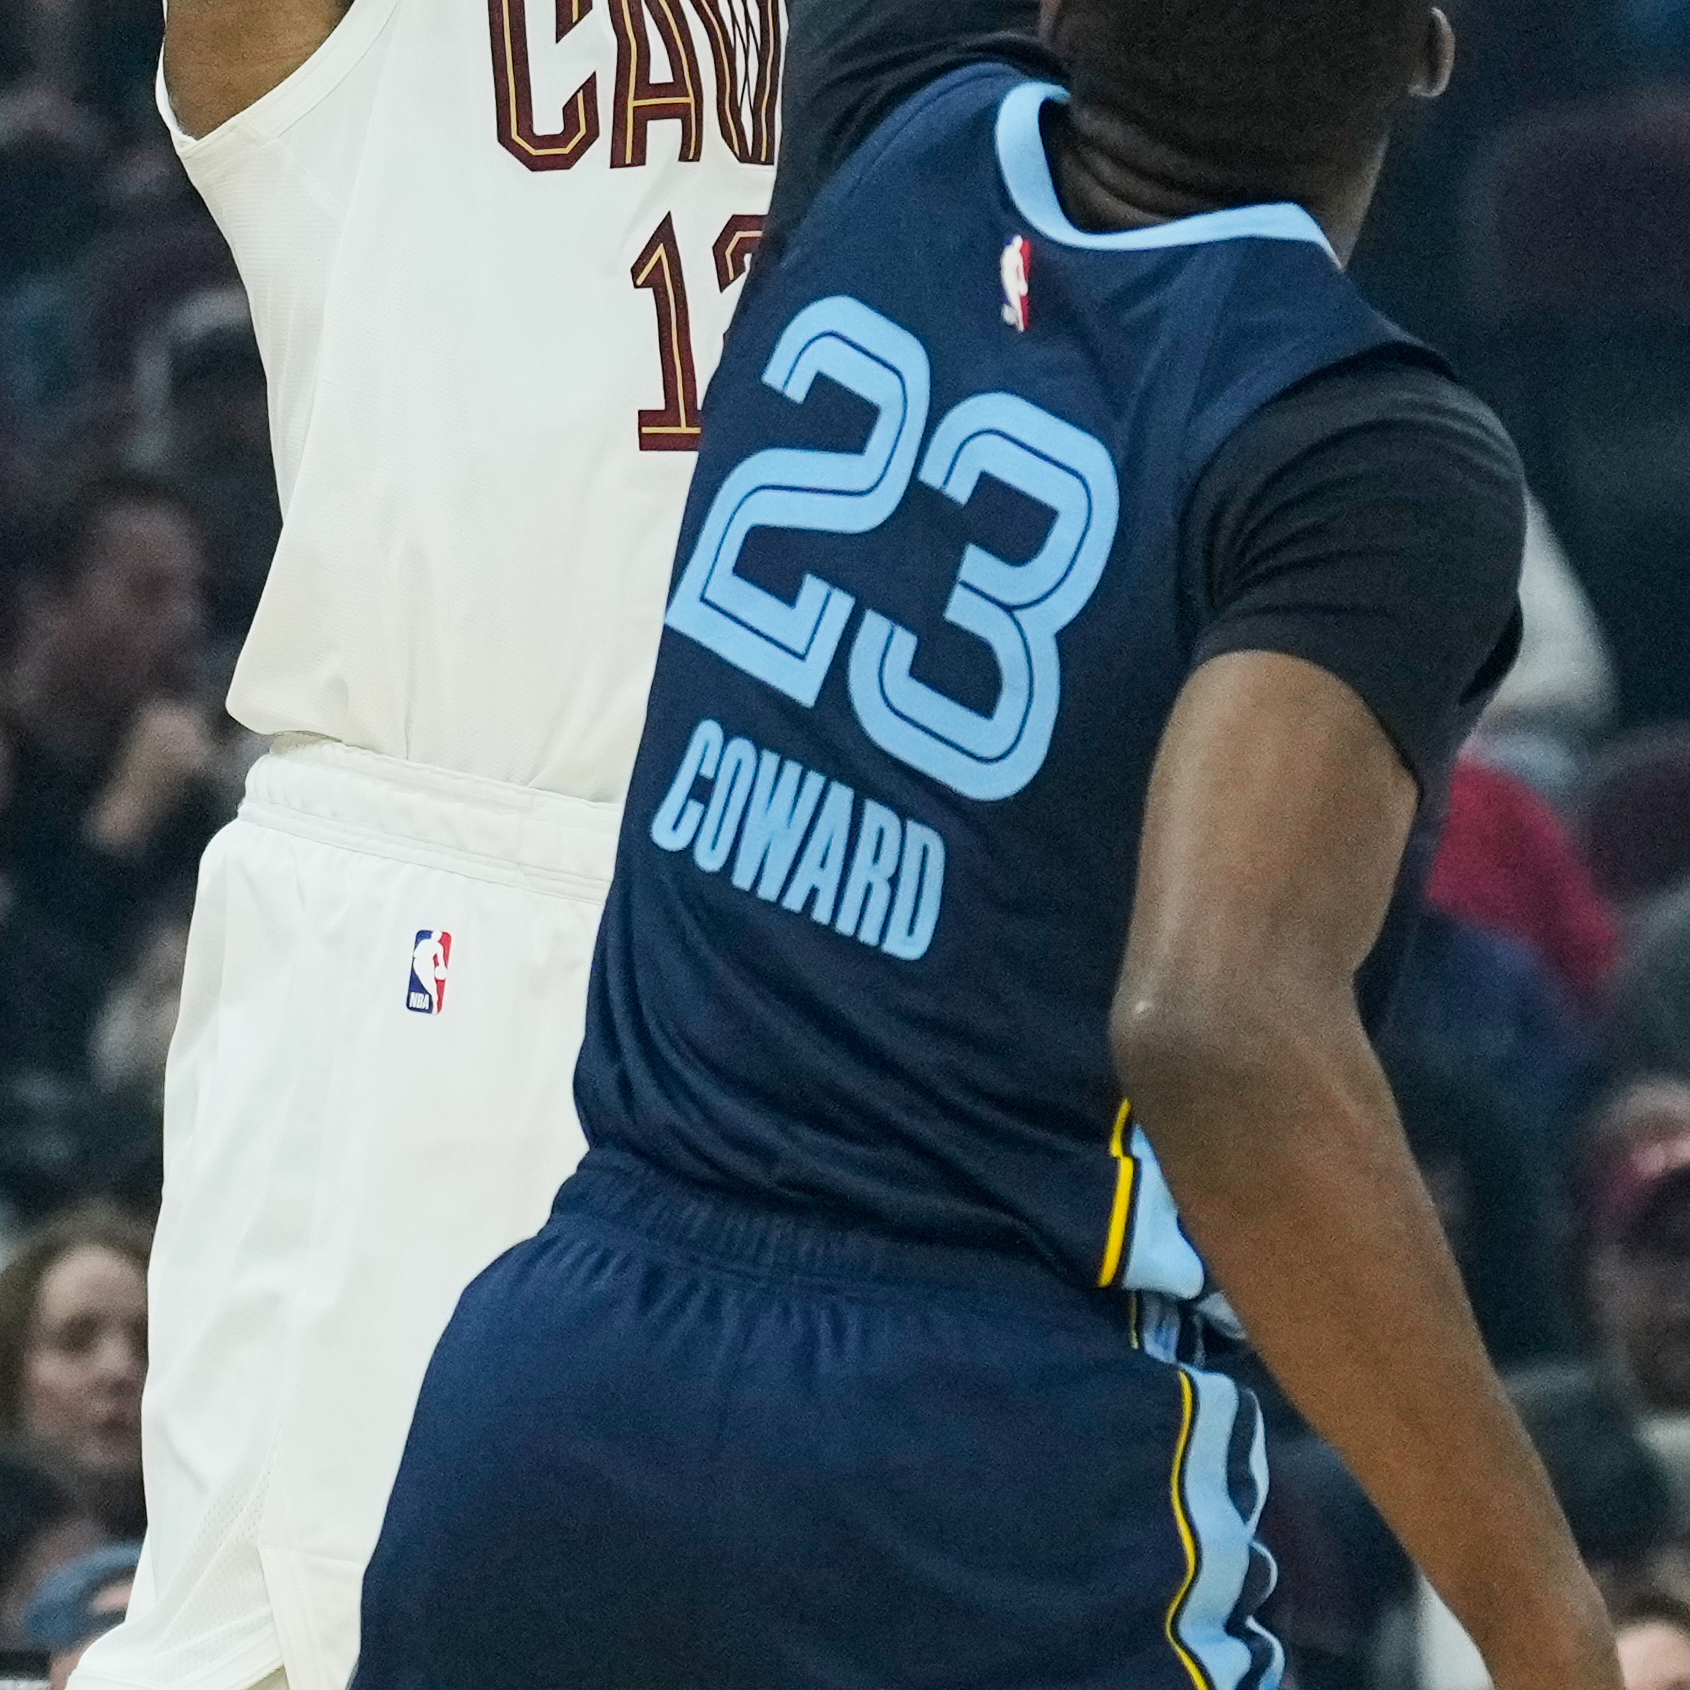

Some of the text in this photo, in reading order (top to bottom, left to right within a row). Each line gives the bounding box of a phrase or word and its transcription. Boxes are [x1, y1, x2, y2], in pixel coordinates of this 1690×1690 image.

[663, 295, 1120, 802] 23
[649, 718, 947, 962] COWARD
[408, 991, 430, 1010] NBA
